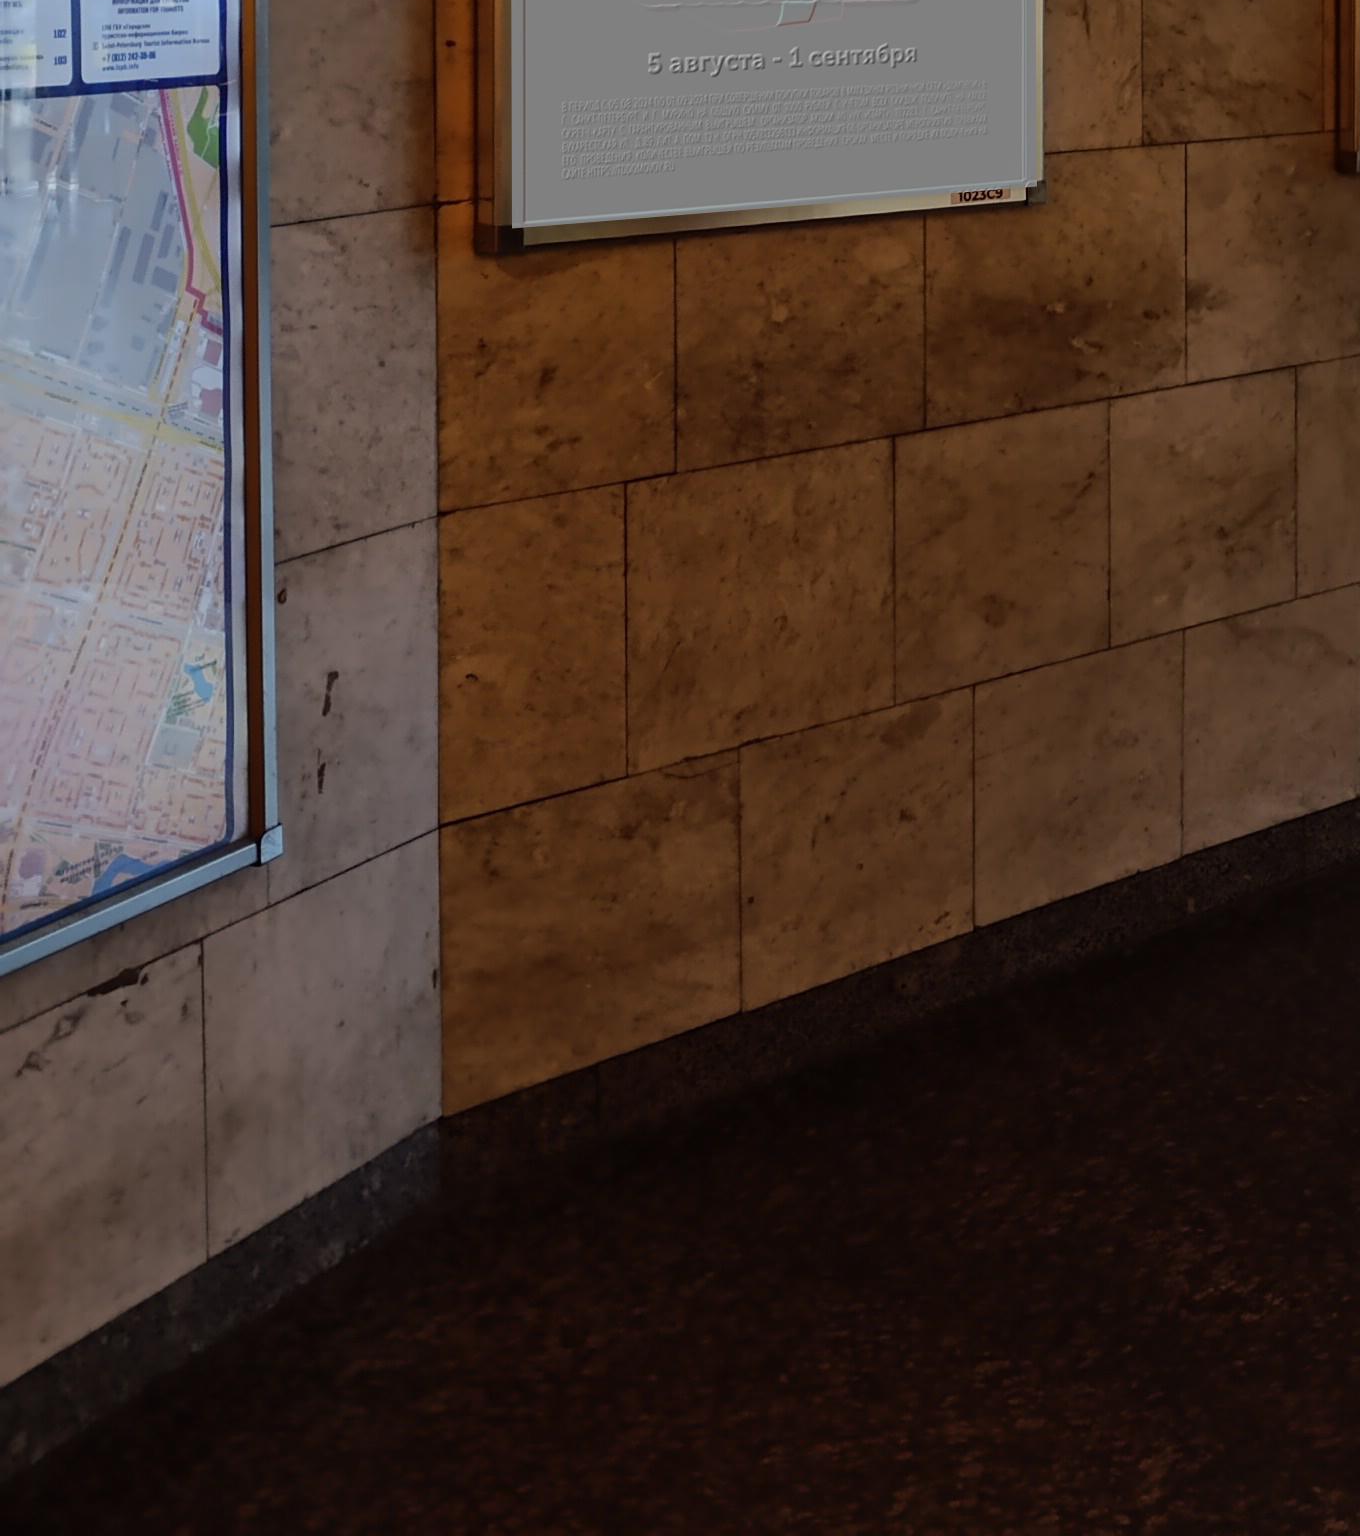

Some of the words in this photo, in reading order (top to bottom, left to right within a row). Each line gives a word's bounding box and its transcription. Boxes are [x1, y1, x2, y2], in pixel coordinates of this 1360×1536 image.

[647, 52, 662, 75] 5
[668, 51, 764, 78] августа
[788, 47, 803, 68] 1
[807, 43, 918, 70] сентября
